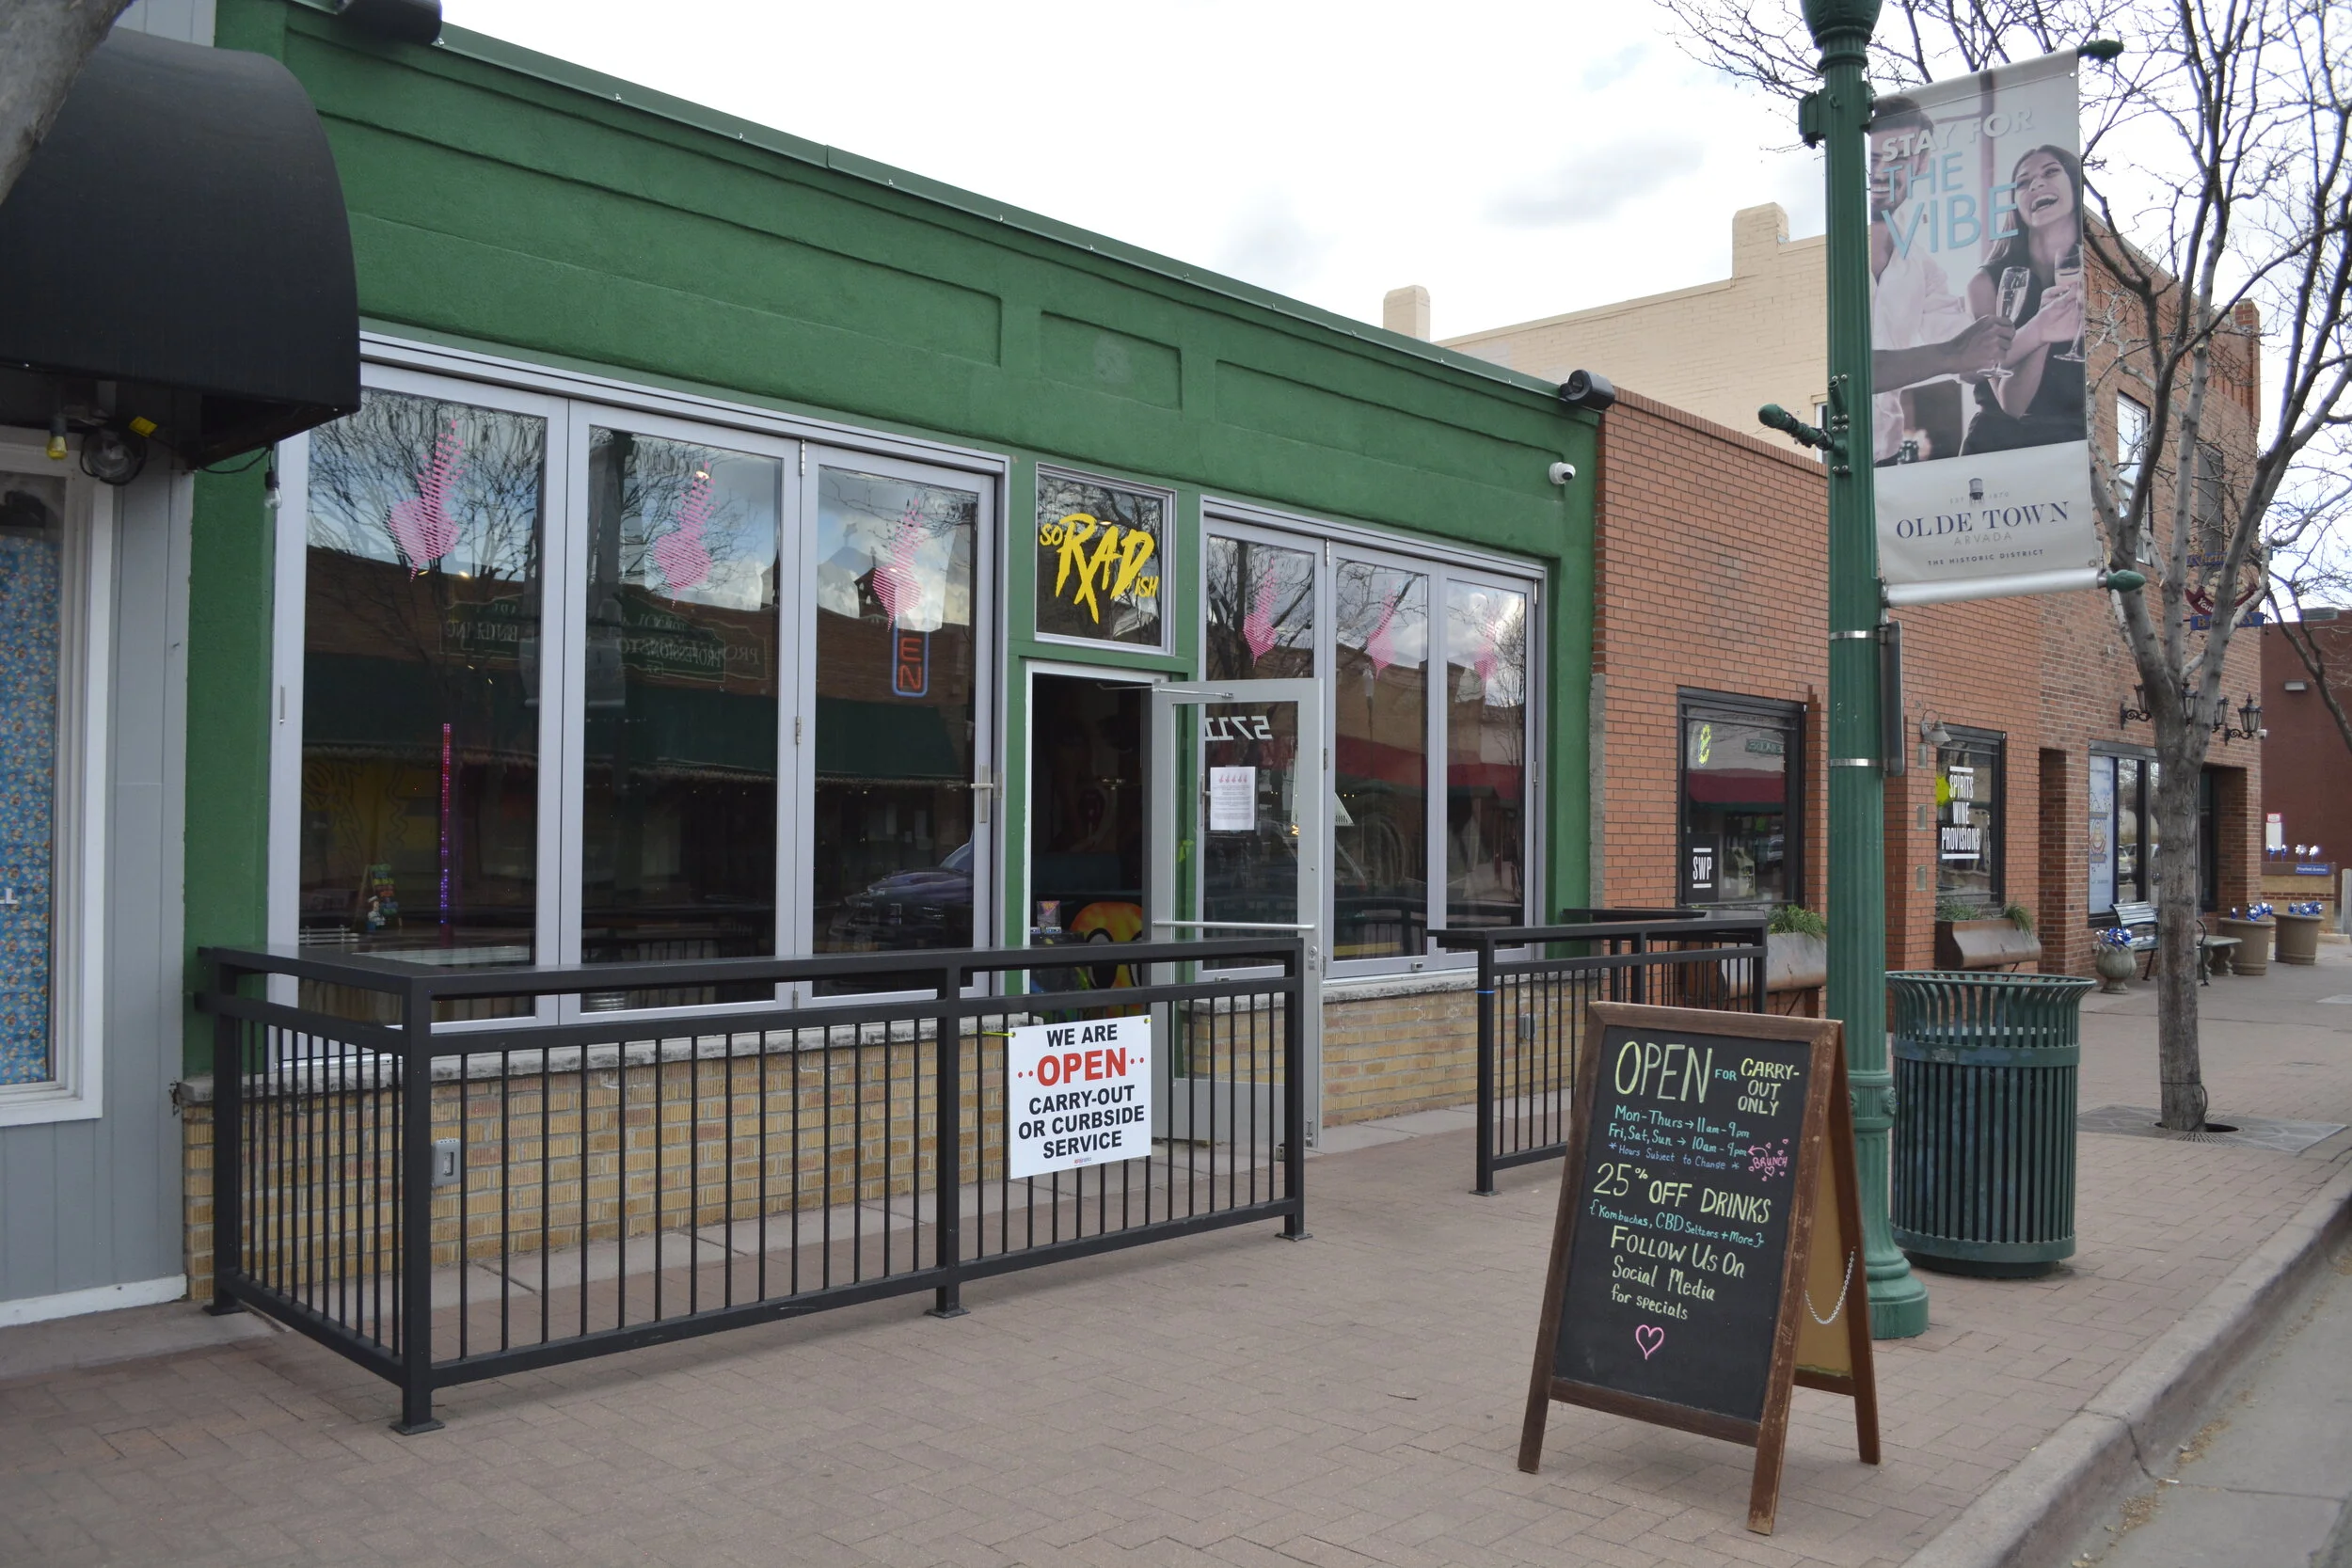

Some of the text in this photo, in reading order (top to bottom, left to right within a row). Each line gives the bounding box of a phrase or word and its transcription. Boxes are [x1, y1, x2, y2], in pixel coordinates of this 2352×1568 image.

[1882, 108, 2033, 163] STAY FOR
[1882, 150, 1964, 204] THE
[1882, 182, 2019, 261] VIBE
[1896, 500, 2070, 539] OLDE TOWN
[1954, 531, 2012, 546] ARVADA
[1948, 553, 1995, 564] HISTORIC
[1998, 548, 2044, 560] DISTRICT
[1948, 774, 1974, 799] SPIRITS
[1953, 801, 1970, 825] WINE
[1941, 827, 1980, 850] PROVISIONS
[1692, 855, 1712, 881] SWP
[1046, 1023, 1118, 1048] WE ARE
[1037, 1047, 1126, 1086] OPEN
[1614, 1040, 1738, 1103] OPEN FOR
[1740, 1057, 1801, 1081] CARRY-
[1028, 1085, 1136, 1116] CARRY-OUT
[1747, 1079, 1782, 1101] OUT
[1738, 1095, 1780, 1117] ONLY
[1018, 1104, 1145, 1140] OR CURBSIDE
[1042, 1130, 1122, 1160] SERVICE
[1645, 1148, 1676, 1163] Subject
[1682, 1153, 1692, 1165] to
[1694, 1155, 1727, 1170] Change
[1752, 1155, 1788, 1170] BRUNCH
[1648, 1180, 1693, 1208] OFF
[1699, 1187, 1772, 1224] DRINKS
[1655, 1212, 1684, 1232] CBD
[1685, 1221, 1719, 1240] Seltzers
[1612, 1254, 1716, 1302] Social Media
[1611, 1283, 1689, 1321] for specials
